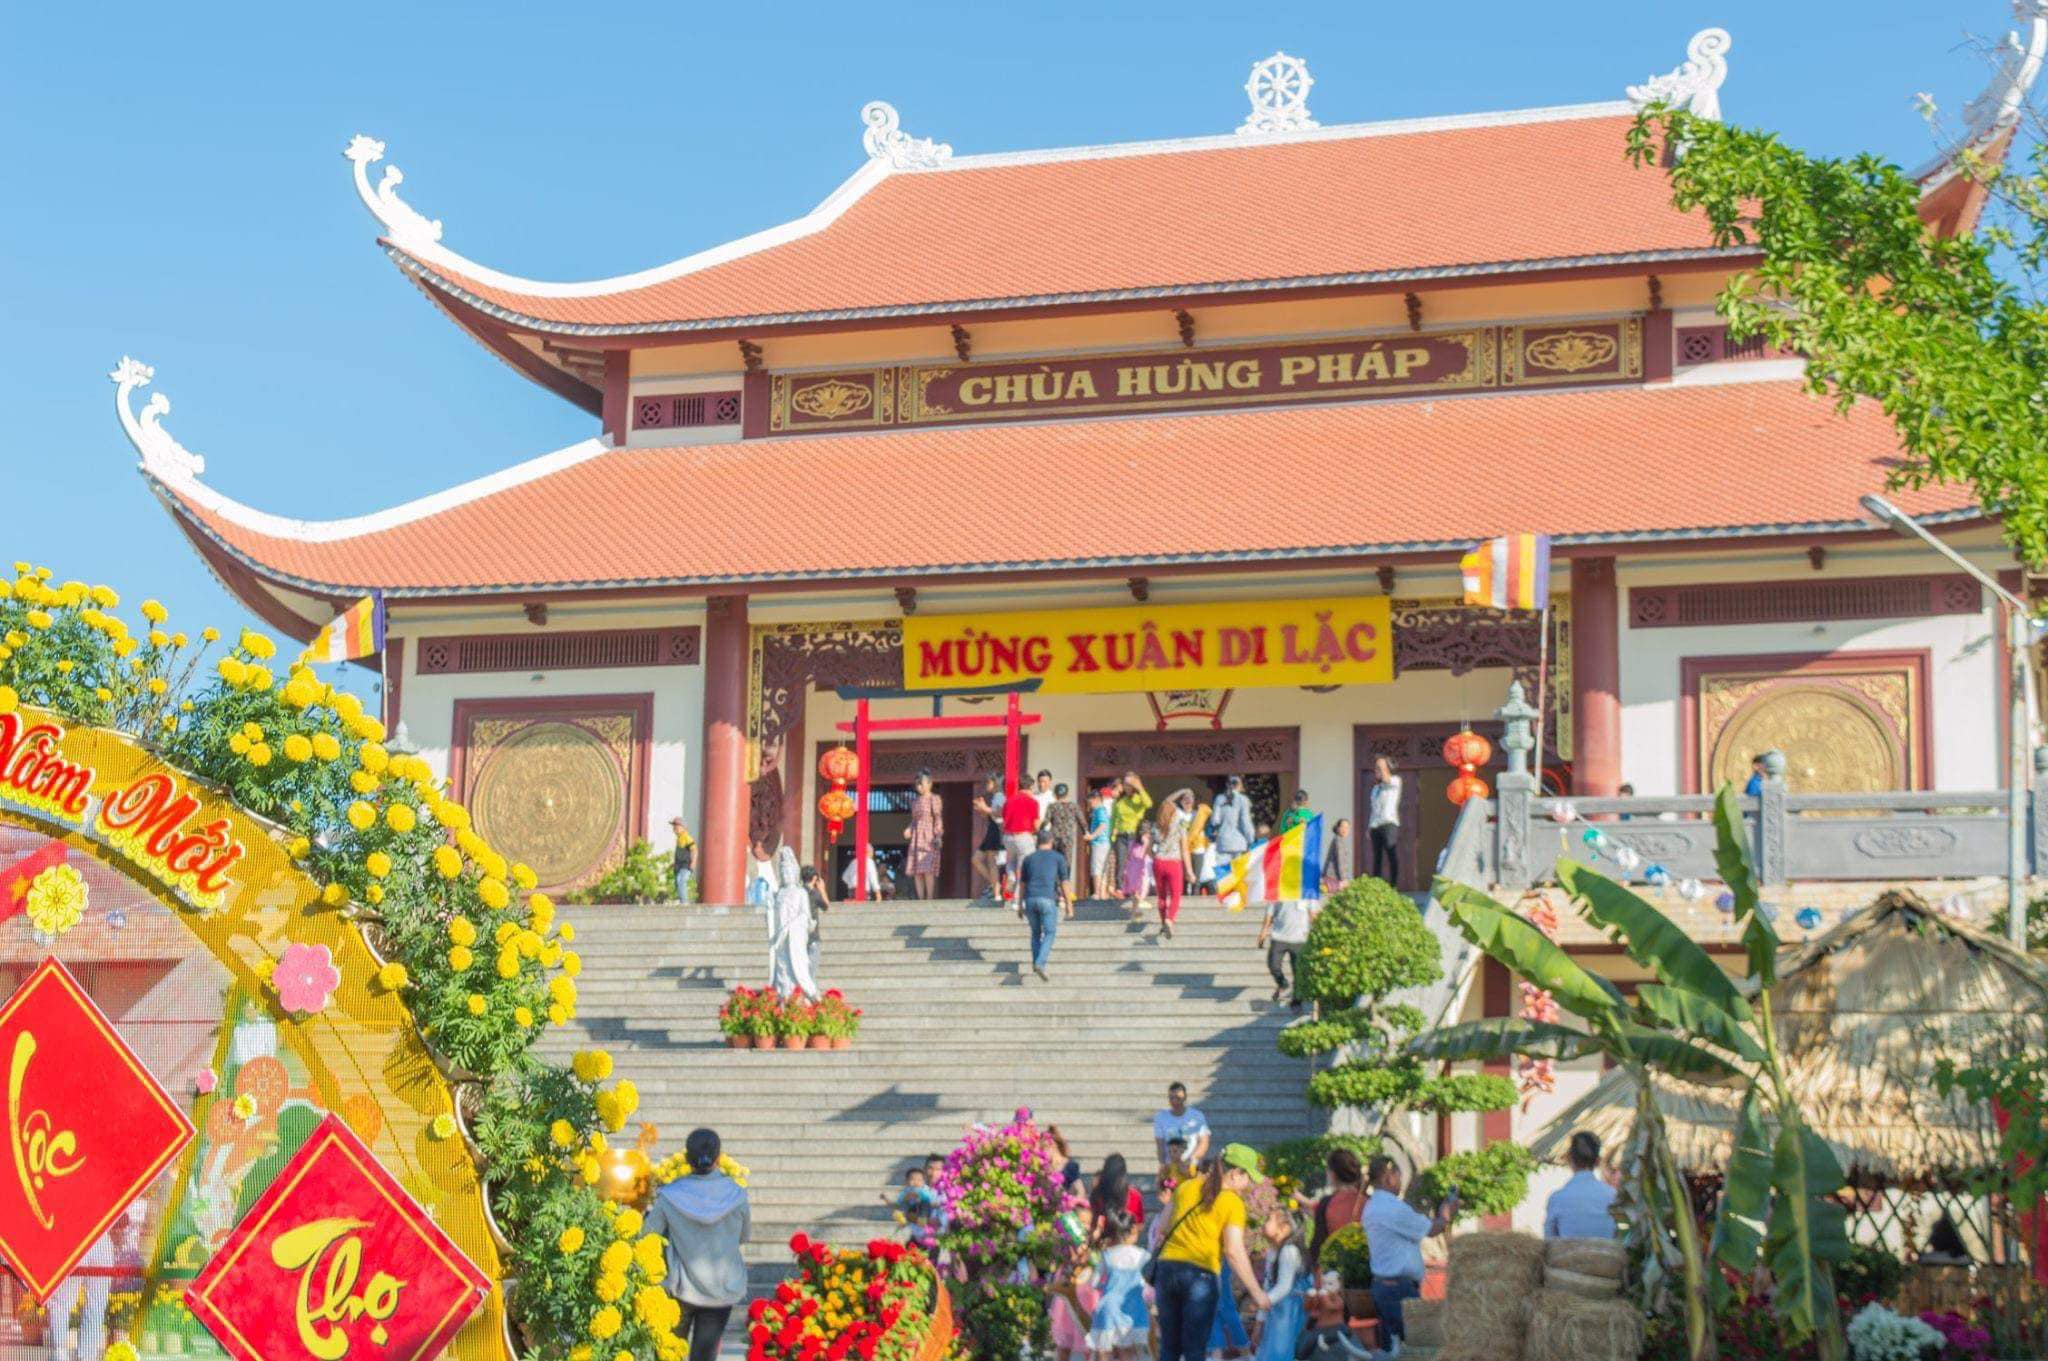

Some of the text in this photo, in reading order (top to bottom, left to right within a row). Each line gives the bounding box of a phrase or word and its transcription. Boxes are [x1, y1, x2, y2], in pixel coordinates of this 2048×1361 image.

[958, 343, 1431, 406] CHÙA HƯNG PHÁP
[918, 610, 1377, 679] MỪNG XUÂN DI LẶC
[102, 773, 244, 894] Mới
[270, 1216, 407, 1361] Thọ
